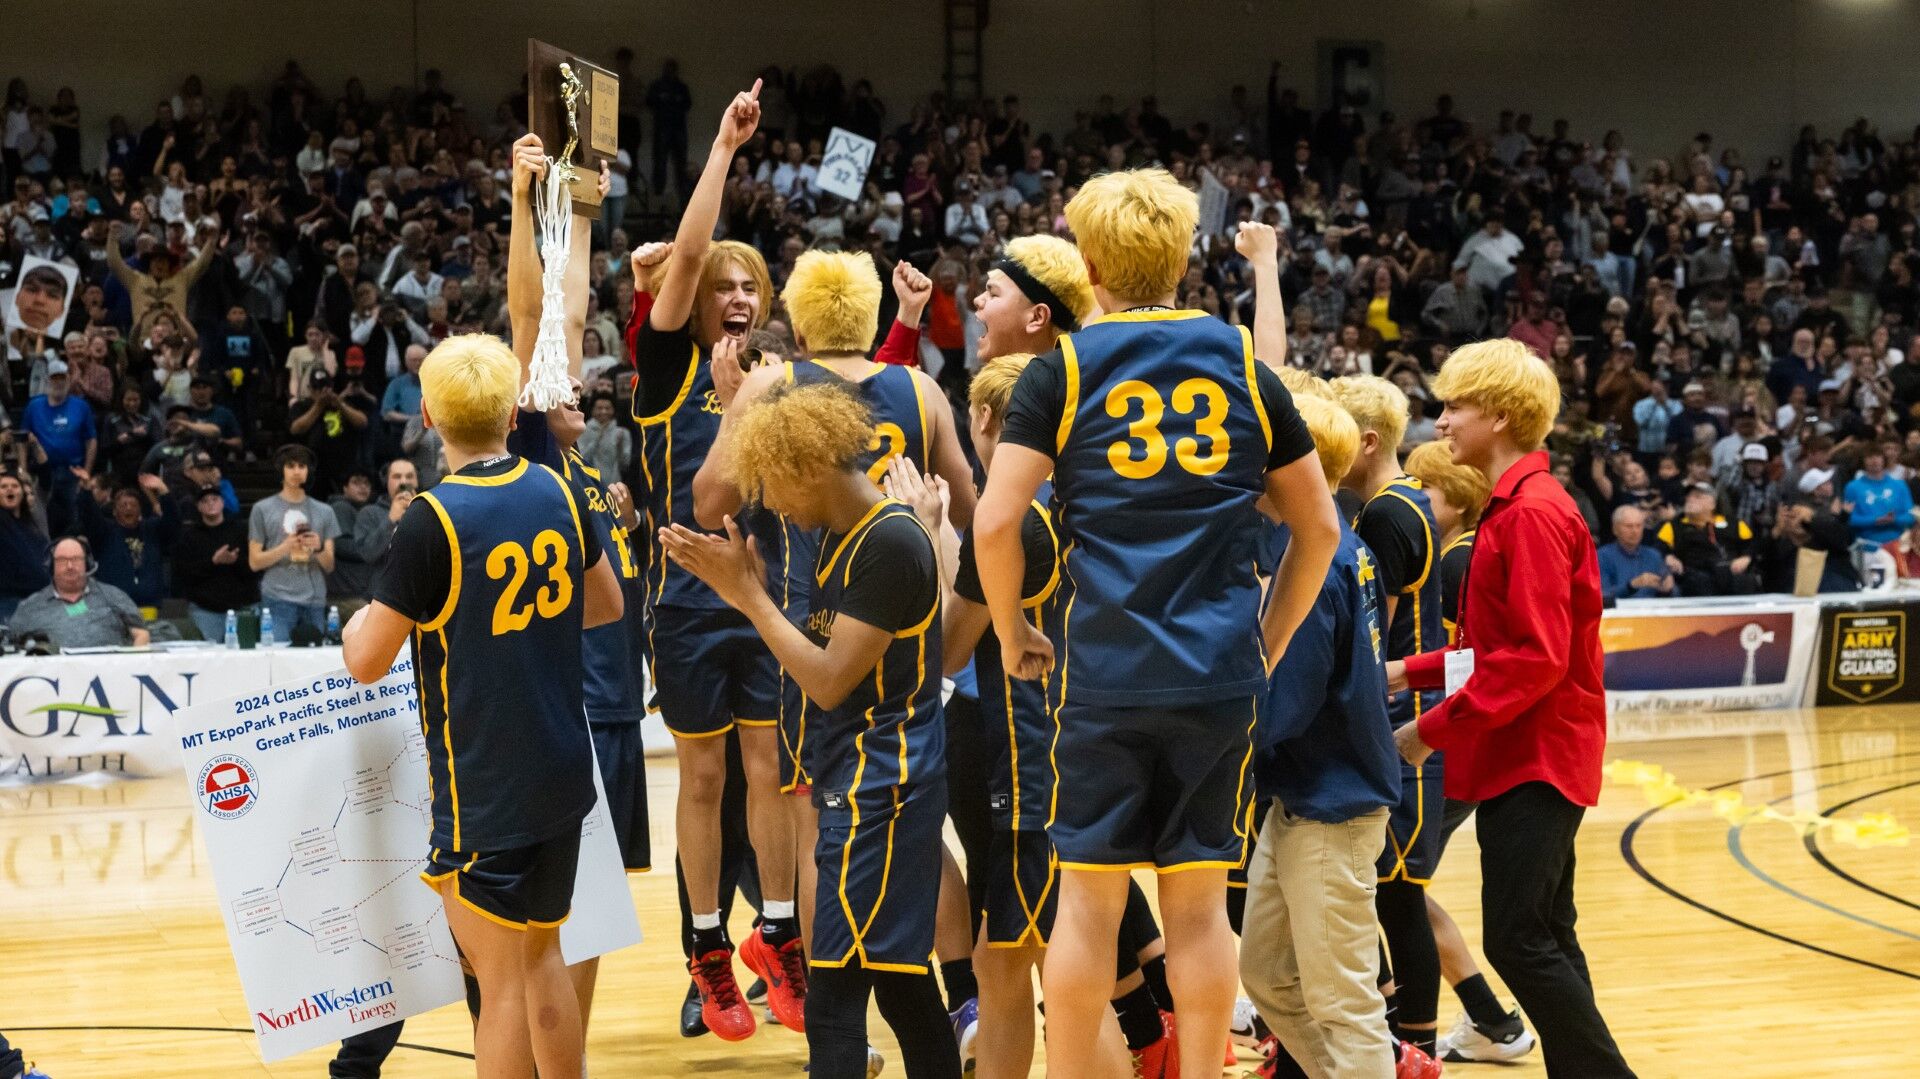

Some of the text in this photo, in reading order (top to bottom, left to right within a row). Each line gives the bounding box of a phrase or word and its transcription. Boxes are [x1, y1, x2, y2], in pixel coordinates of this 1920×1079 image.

[1105, 377, 1232, 479] 33
[864, 422, 907, 496] 2
[485, 529, 574, 636] 23
[1842, 631, 1897, 649] ARMY
[1838, 659, 1897, 676] GUARD
[235, 695, 269, 714] 2024
[274, 685, 309, 704] Class
[312, 681, 323, 693] C
[326, 672, 358, 691] Boys
[182, 680, 417, 749] MT ExpoPark Pacific Steel & Recyc
[256, 730, 295, 751] Great
[299, 722, 334, 742] Falls,
[337, 706, 397, 731] Montana
[0, 753, 126, 776] ALTH
[199, 763, 213, 796] MONTANA
[235, 758, 256, 782] SCHOOL
[209, 784, 255, 810] MHSA
[213, 800, 253, 818] ASSOCIATION
[257, 979, 395, 1036] NorthWestern
[348, 1000, 398, 1024] Energy
